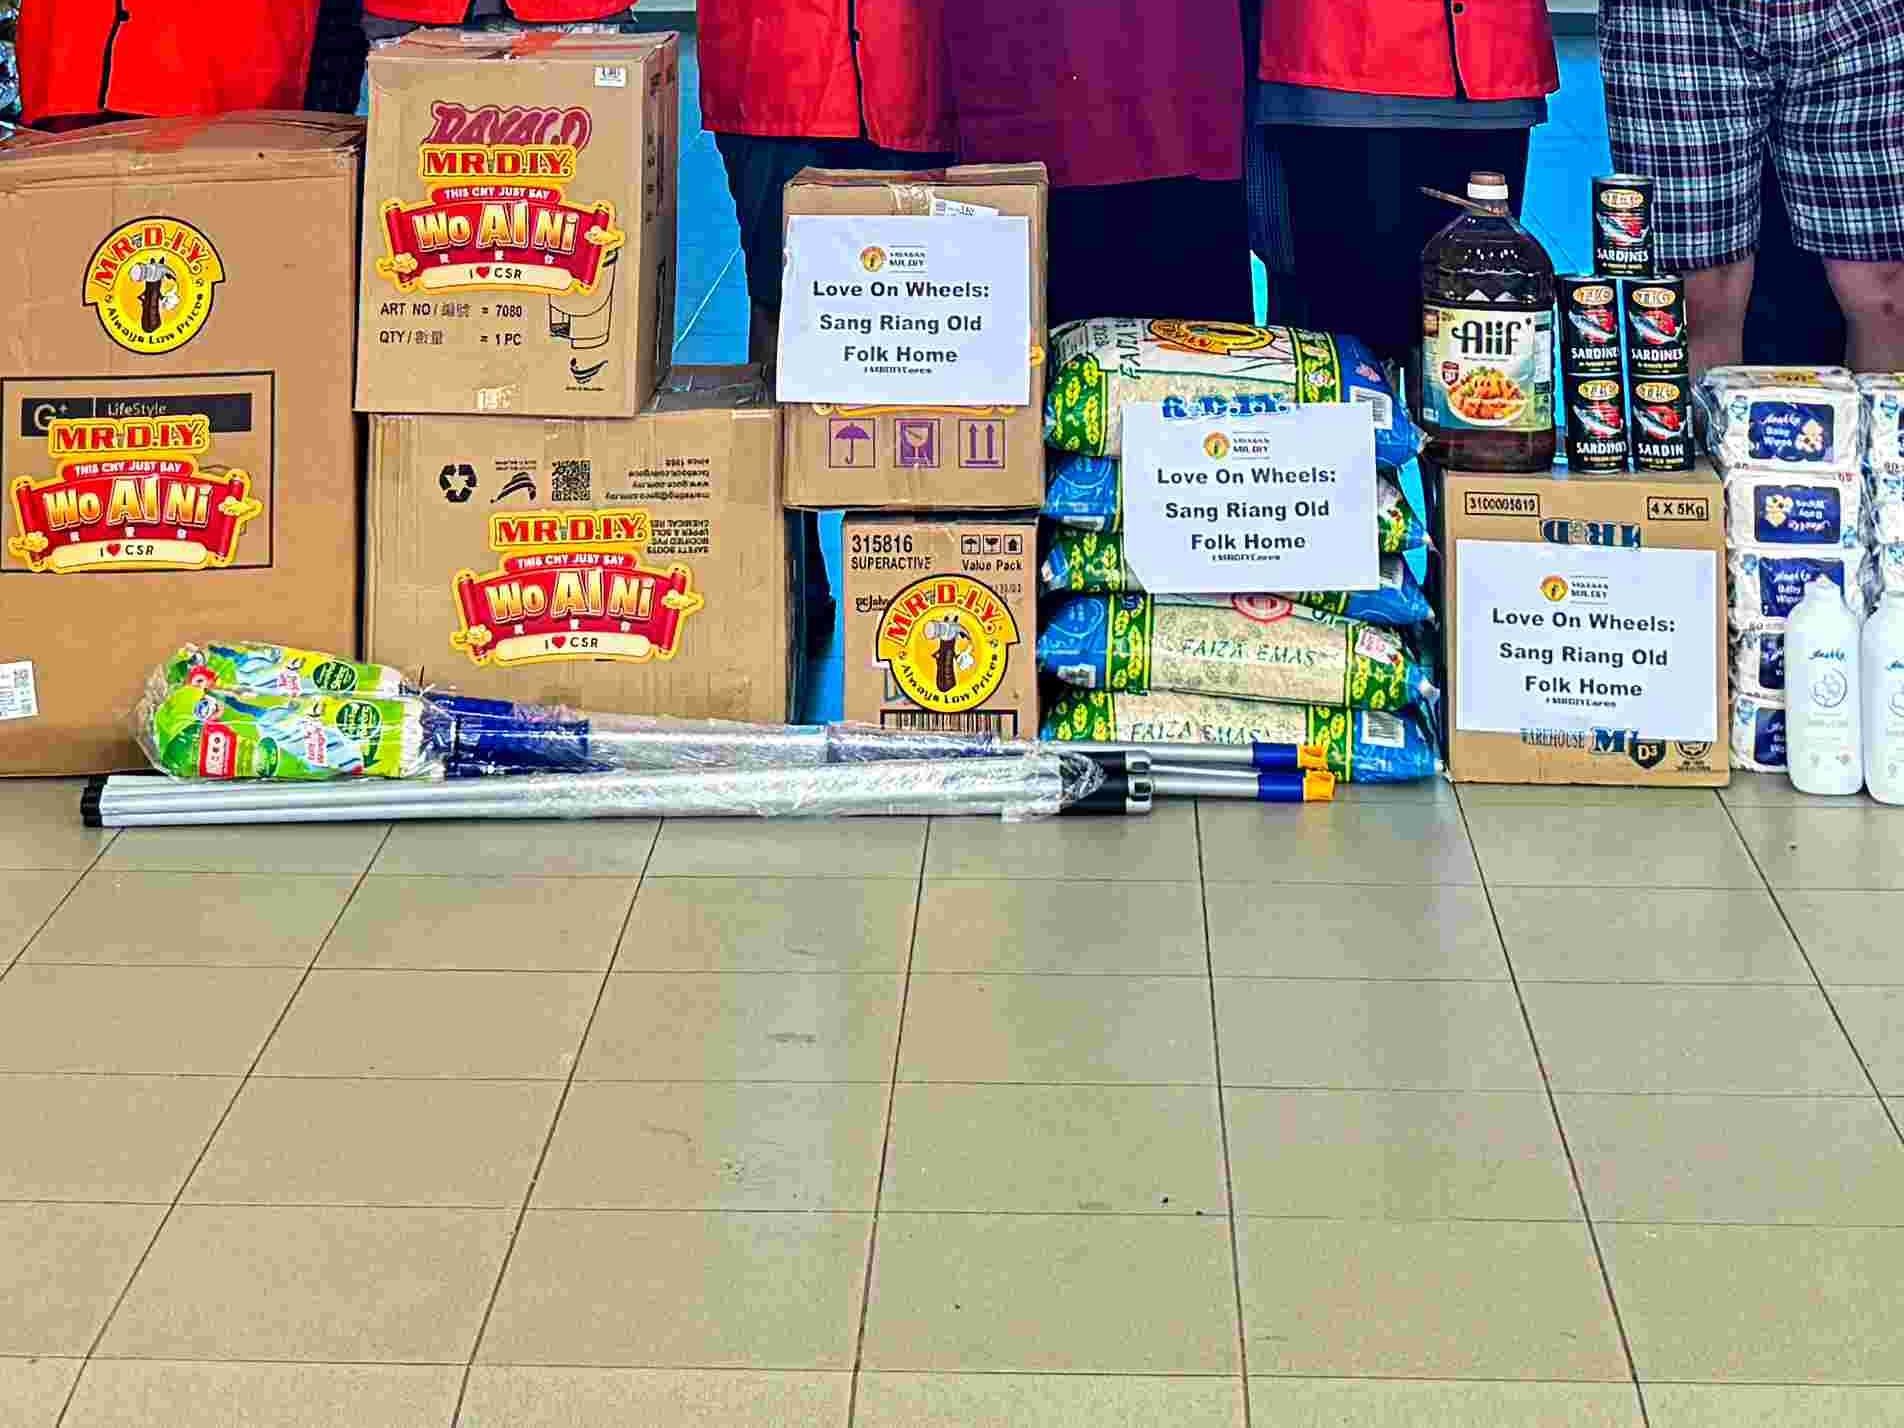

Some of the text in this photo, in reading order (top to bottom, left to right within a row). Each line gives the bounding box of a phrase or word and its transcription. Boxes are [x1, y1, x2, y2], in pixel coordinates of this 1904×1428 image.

[412, 209, 474, 252] Wo
[531, 208, 580, 256] Ni
[494, 268, 523, 280] CSR
[812, 280, 990, 298] Love On Wheels:
[820, 314, 982, 334] Sang Riang Old
[843, 346, 958, 363] Folk Home
[1157, 467, 1336, 485] Love On Wheels:
[44, 488, 102, 532] Wo
[163, 481, 214, 529] Ni
[1165, 501, 1330, 522] Sang Riang Old
[125, 544, 154, 555] CSR
[851, 534, 913, 553] 315816
[1191, 533, 1307, 550] Folk Home
[851, 555, 933, 570] SUPERACTIVE
[962, 558, 1024, 571] Value Pack
[486, 580, 546, 624] Wo
[607, 576, 657, 621] Ni
[1492, 607, 1676, 633] Love On Wheels:
[1181, 637, 1317, 667] FAIZA EMAS
[1499, 642, 1668, 668] Sang Riang Old
[1524, 675, 1643, 698] Folk Home
